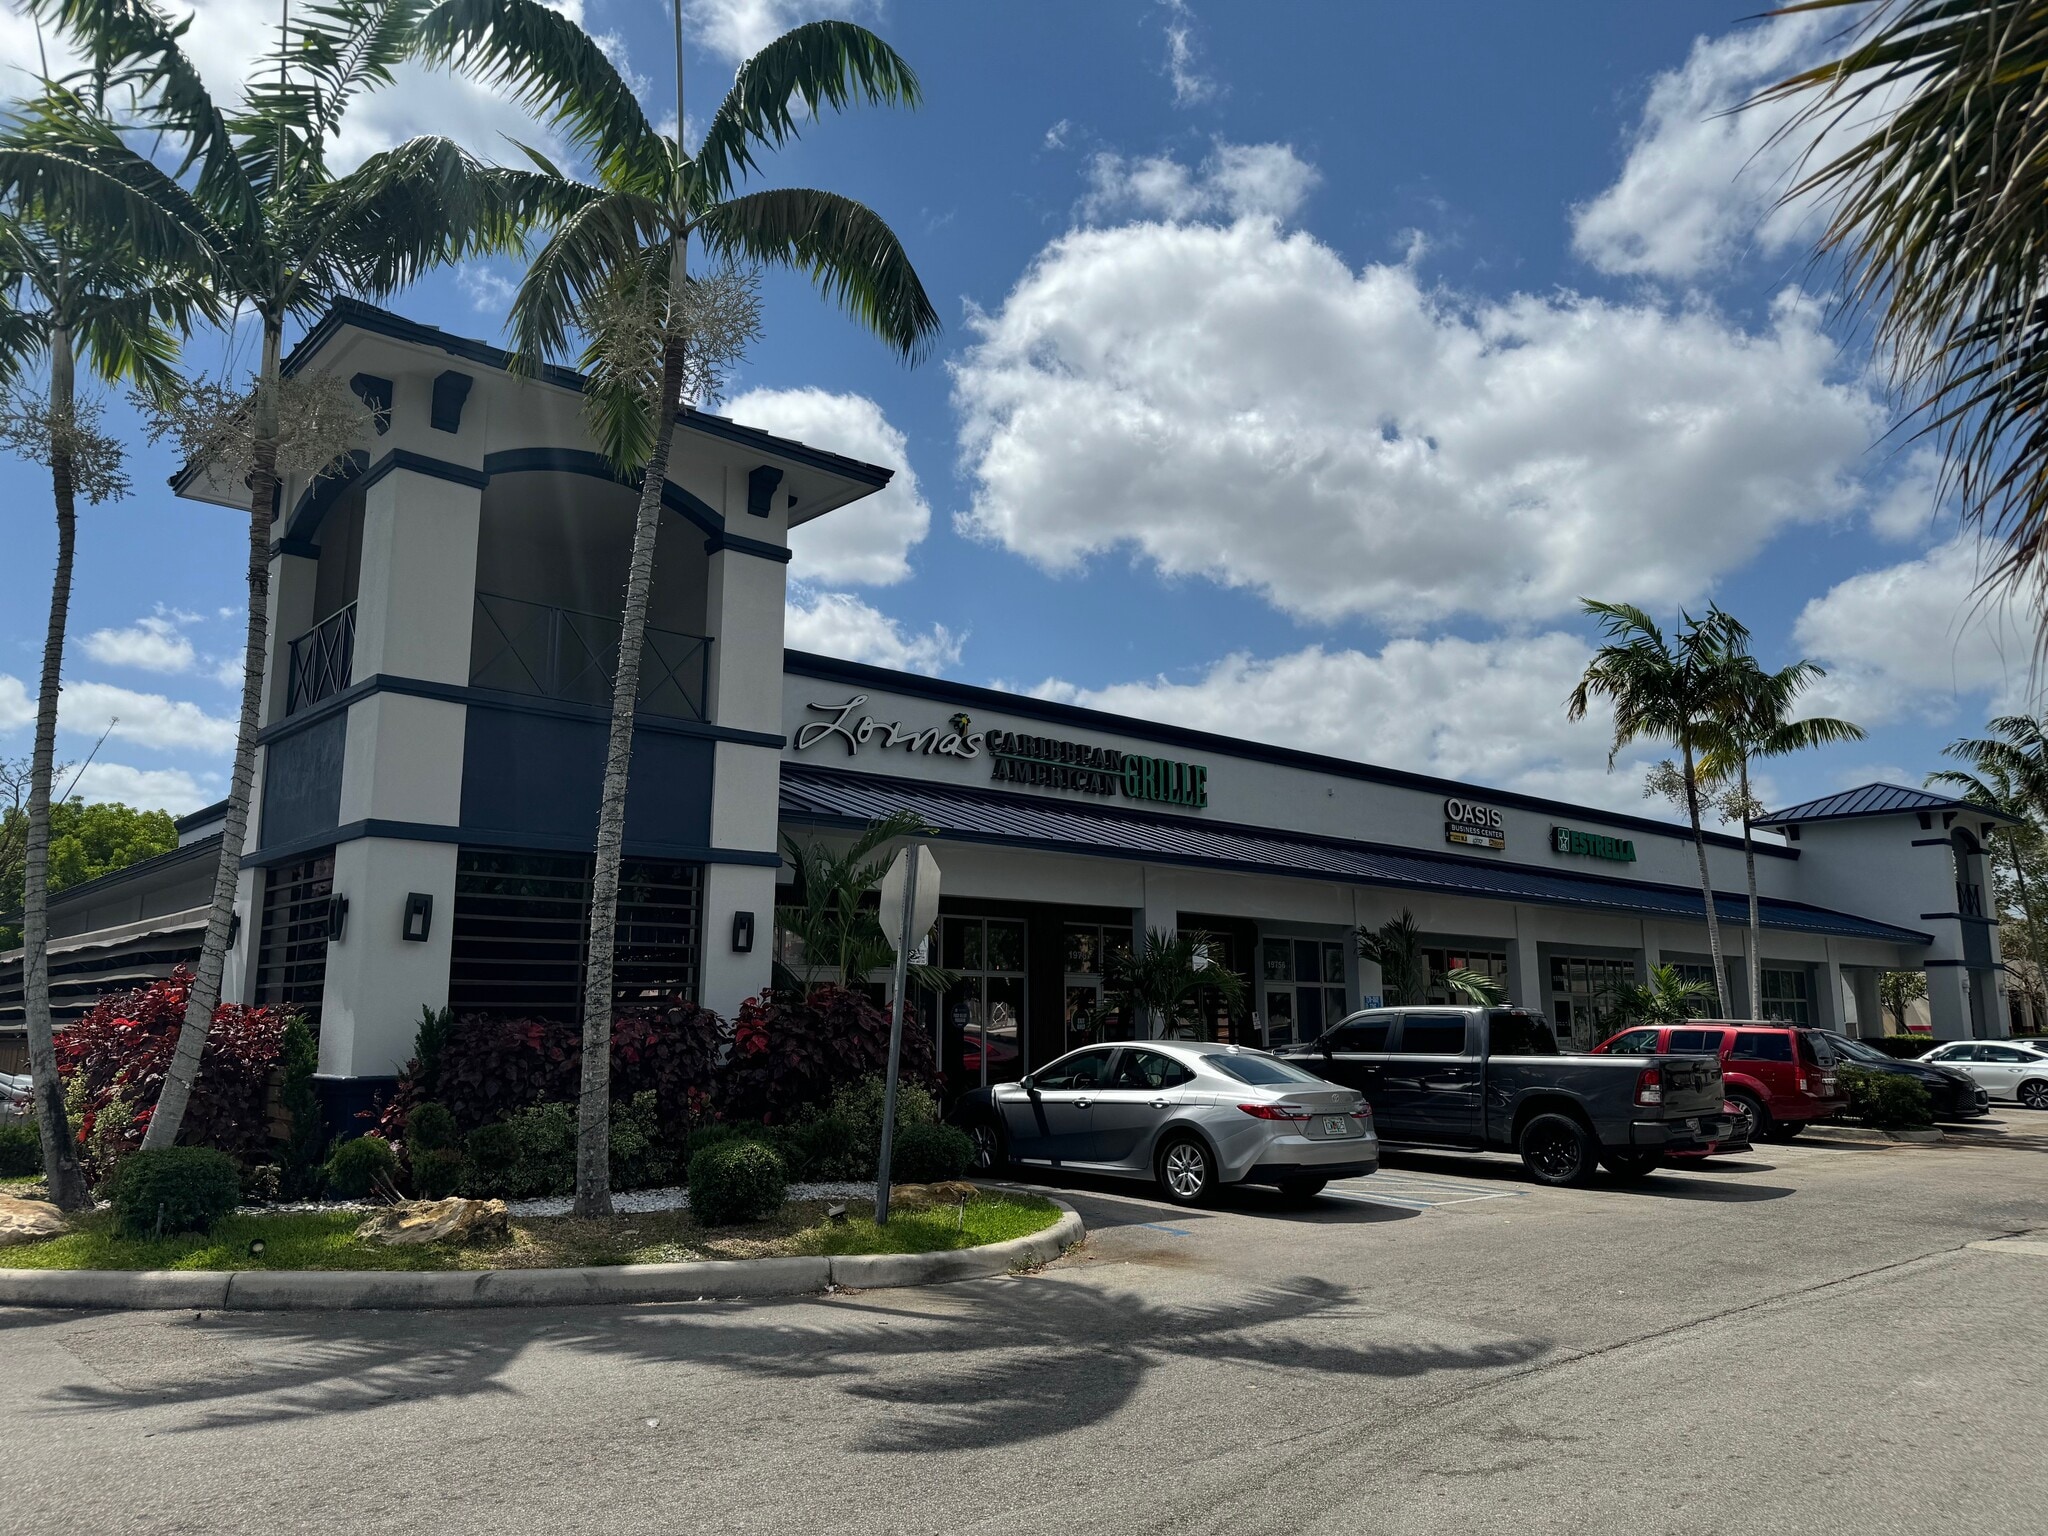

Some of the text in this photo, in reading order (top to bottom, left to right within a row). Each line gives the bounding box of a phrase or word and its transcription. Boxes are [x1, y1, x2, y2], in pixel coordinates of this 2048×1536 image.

[985, 729, 1122, 770] CARIBBEAN
[991, 758, 1117, 796] AMERICAN
[1121, 753, 1208, 808] GRILLE
[1446, 798, 1502, 828] OASIS
[1451, 824, 1503, 839] BUSINESS CENTER
[1570, 831, 1637, 862] ESTRELLA
